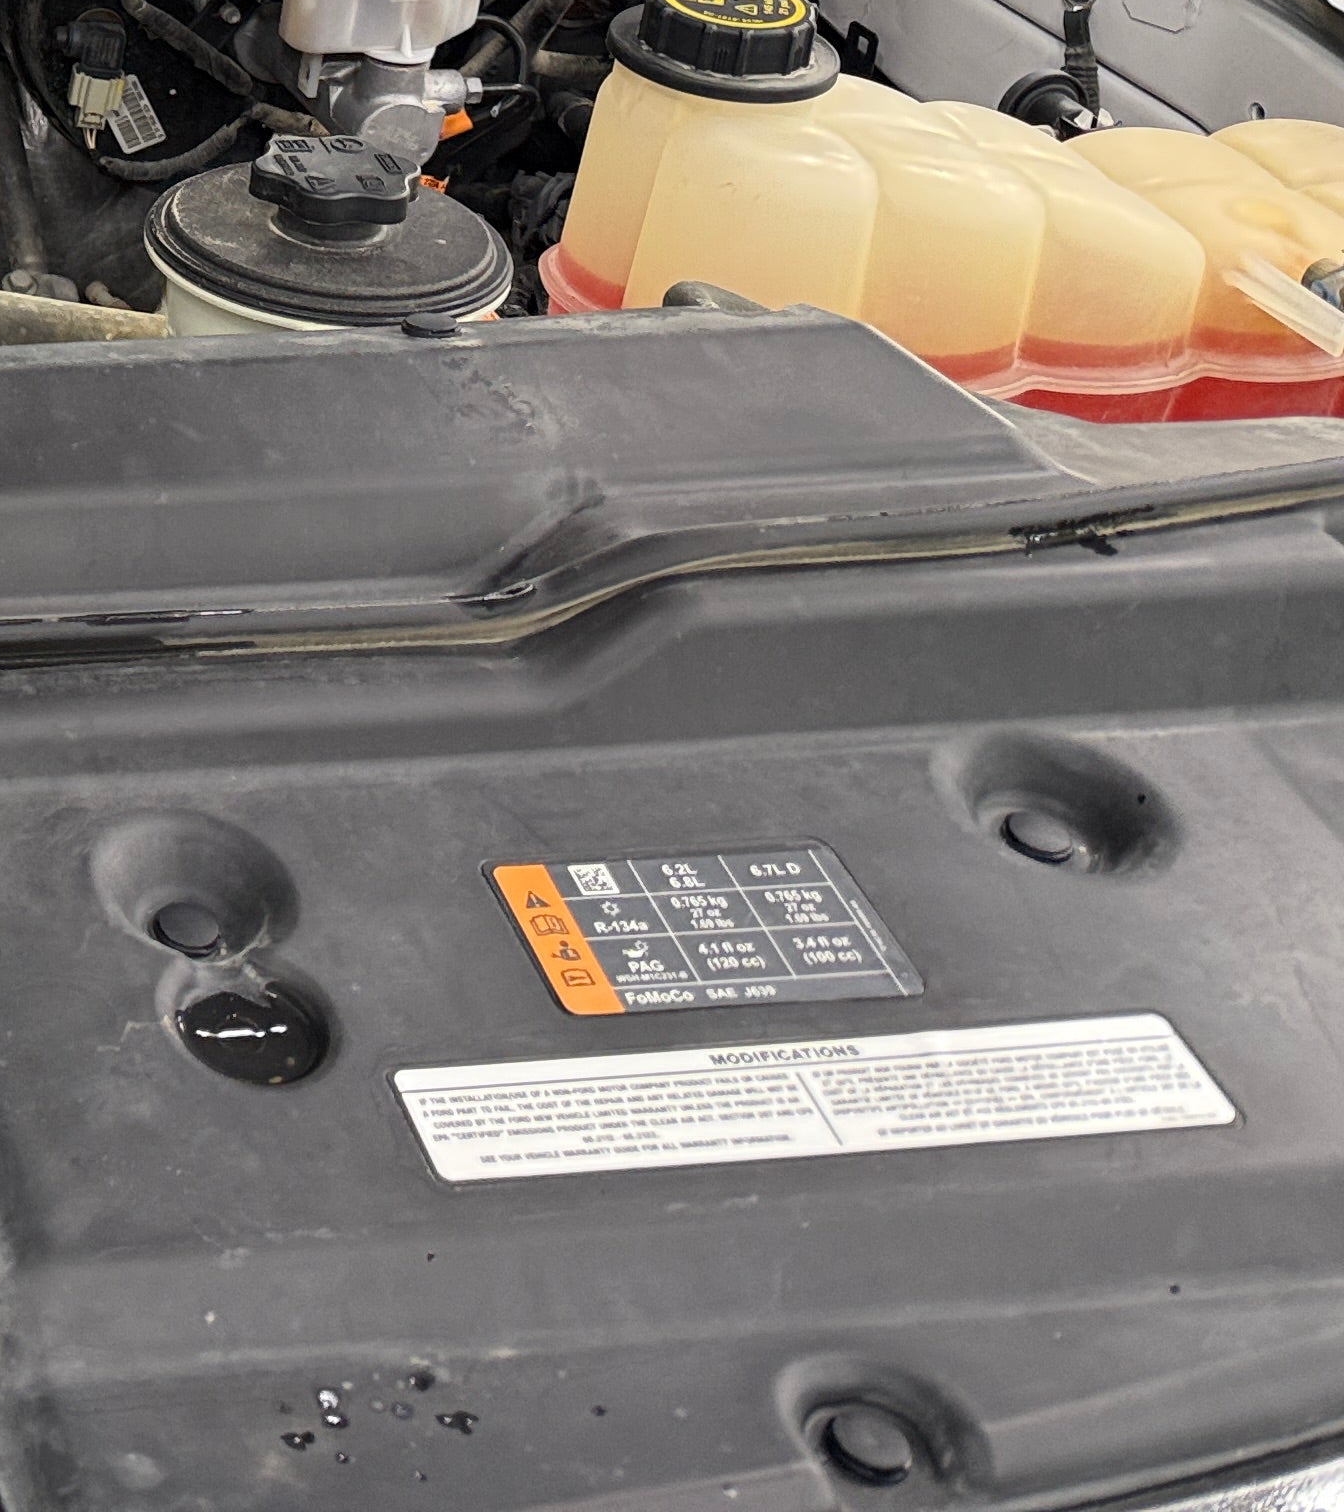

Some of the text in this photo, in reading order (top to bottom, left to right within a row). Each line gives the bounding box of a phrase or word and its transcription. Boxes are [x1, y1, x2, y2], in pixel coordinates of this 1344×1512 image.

[662, 863, 698, 876] 6.2L
[750, 862, 801, 877] 6.7L D
[707, 895, 728, 909] kg
[801, 889, 823, 903] kg
[594, 920, 649, 934] R-134a
[736, 941, 755, 953] oz
[838, 948, 862, 963] cc)
[628, 959, 665, 973] PAG
[707, 955, 766, 971] (120 cc)
[625, 989, 695, 1005] FoMoCo
[706, 987, 738, 1000] SAE
[708, 1044, 860, 1066] MODIFICATIONS
